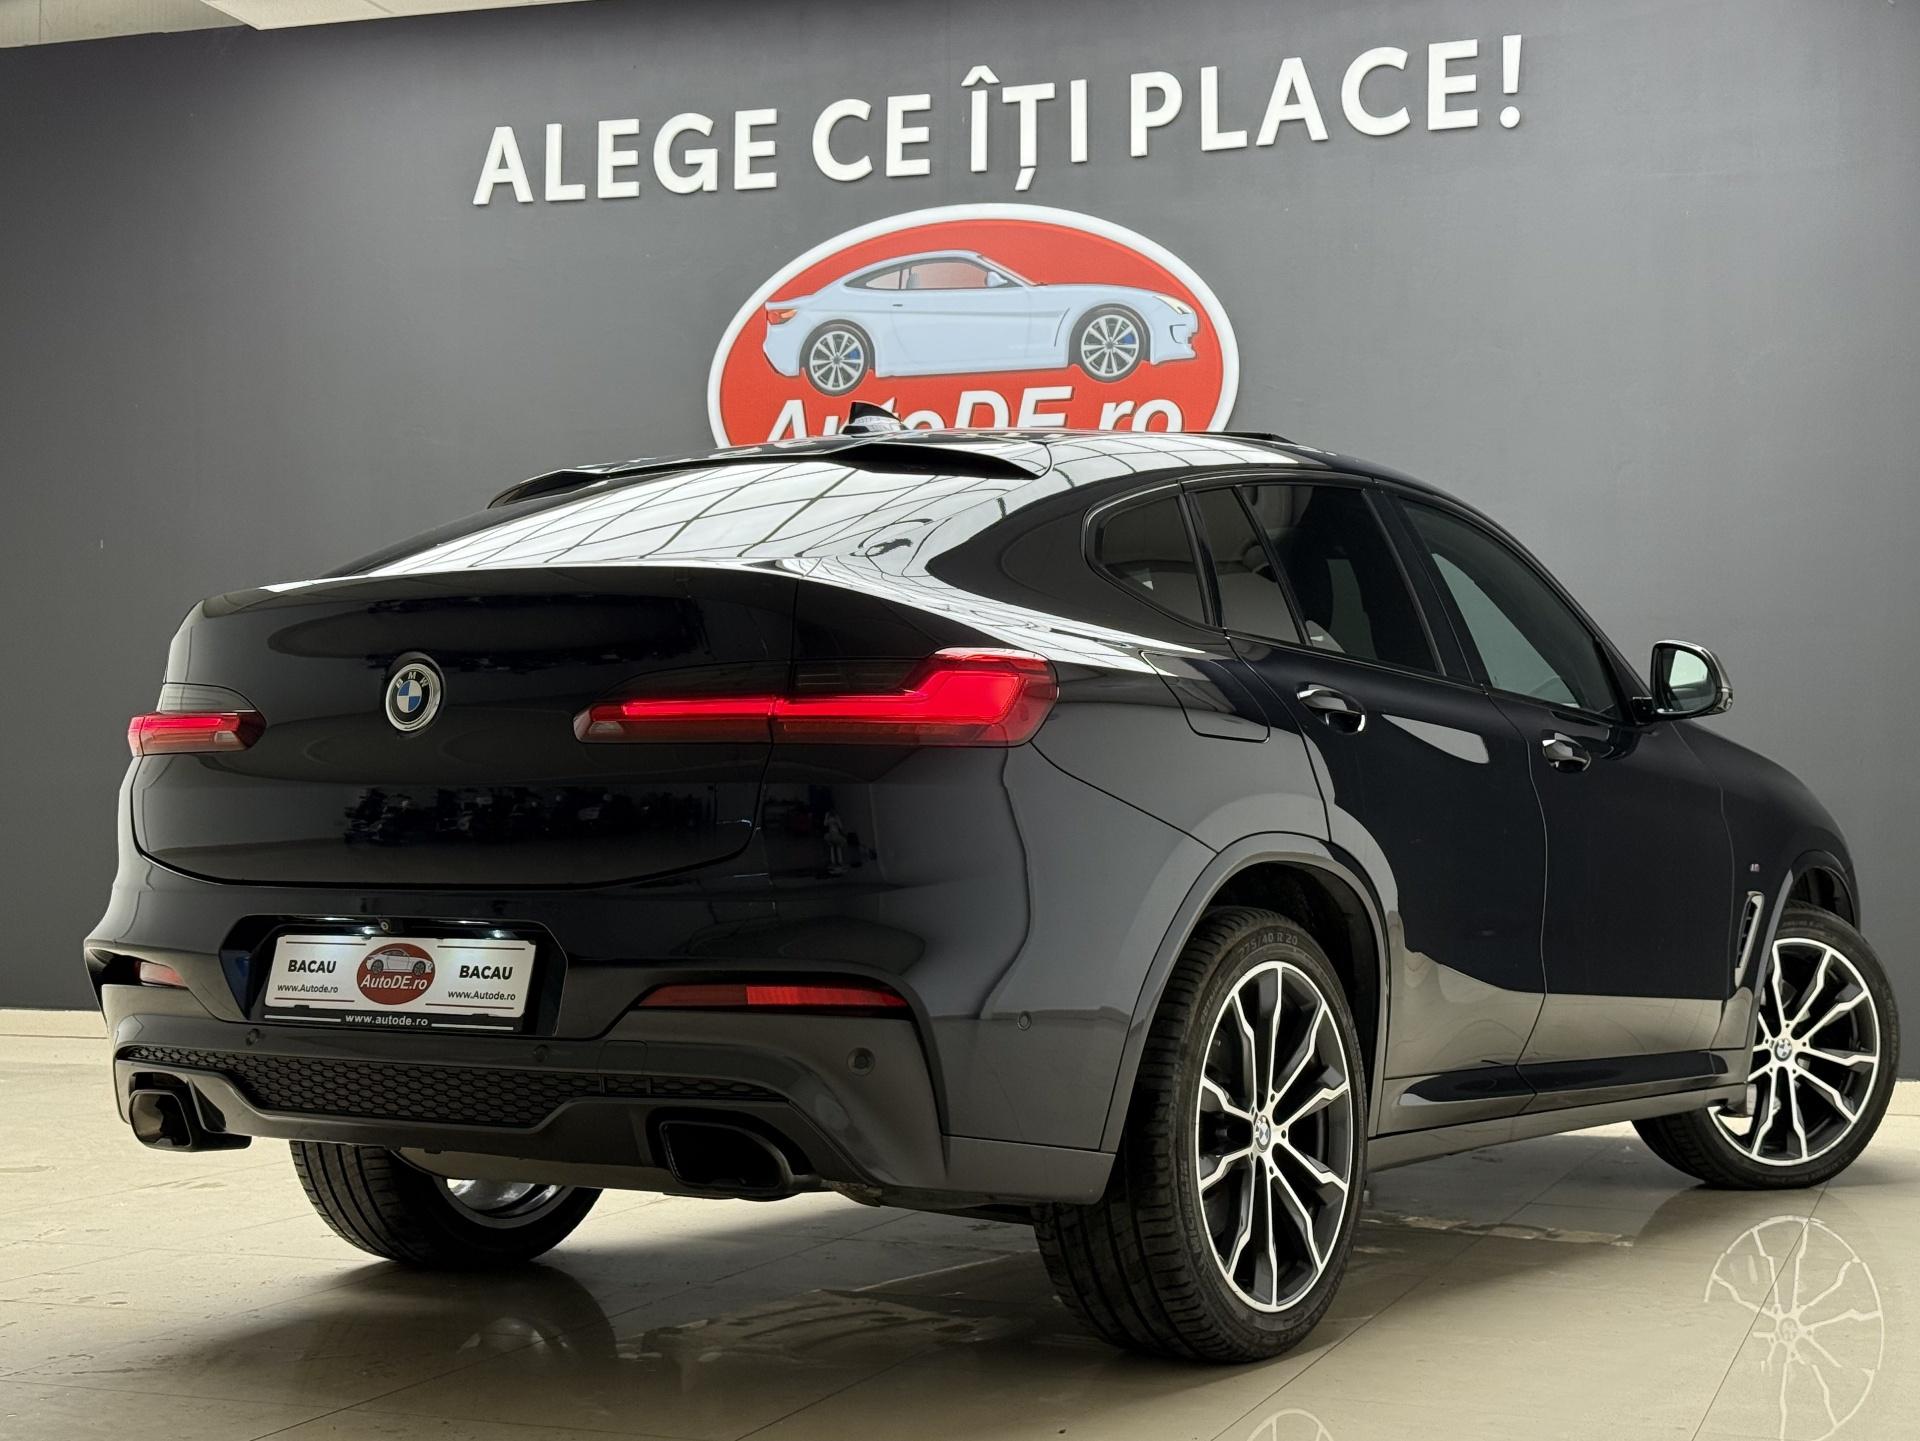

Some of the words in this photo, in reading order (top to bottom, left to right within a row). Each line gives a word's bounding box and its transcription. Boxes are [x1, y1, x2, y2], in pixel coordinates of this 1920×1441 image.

[473, 107, 777, 206] ALEGE
[812, 94, 931, 182] CE
[1130, 34, 1523, 157] PLACE!
[287, 959, 337, 974] BACAU
[458, 965, 513, 980] BACAU
[277, 983, 339, 994] www.Autode.ro
[360, 974, 428, 990] AutoDE.ro
[447, 990, 516, 1001] www.Autode.ro
[345, 1014, 429, 1026] www.autode.ro
